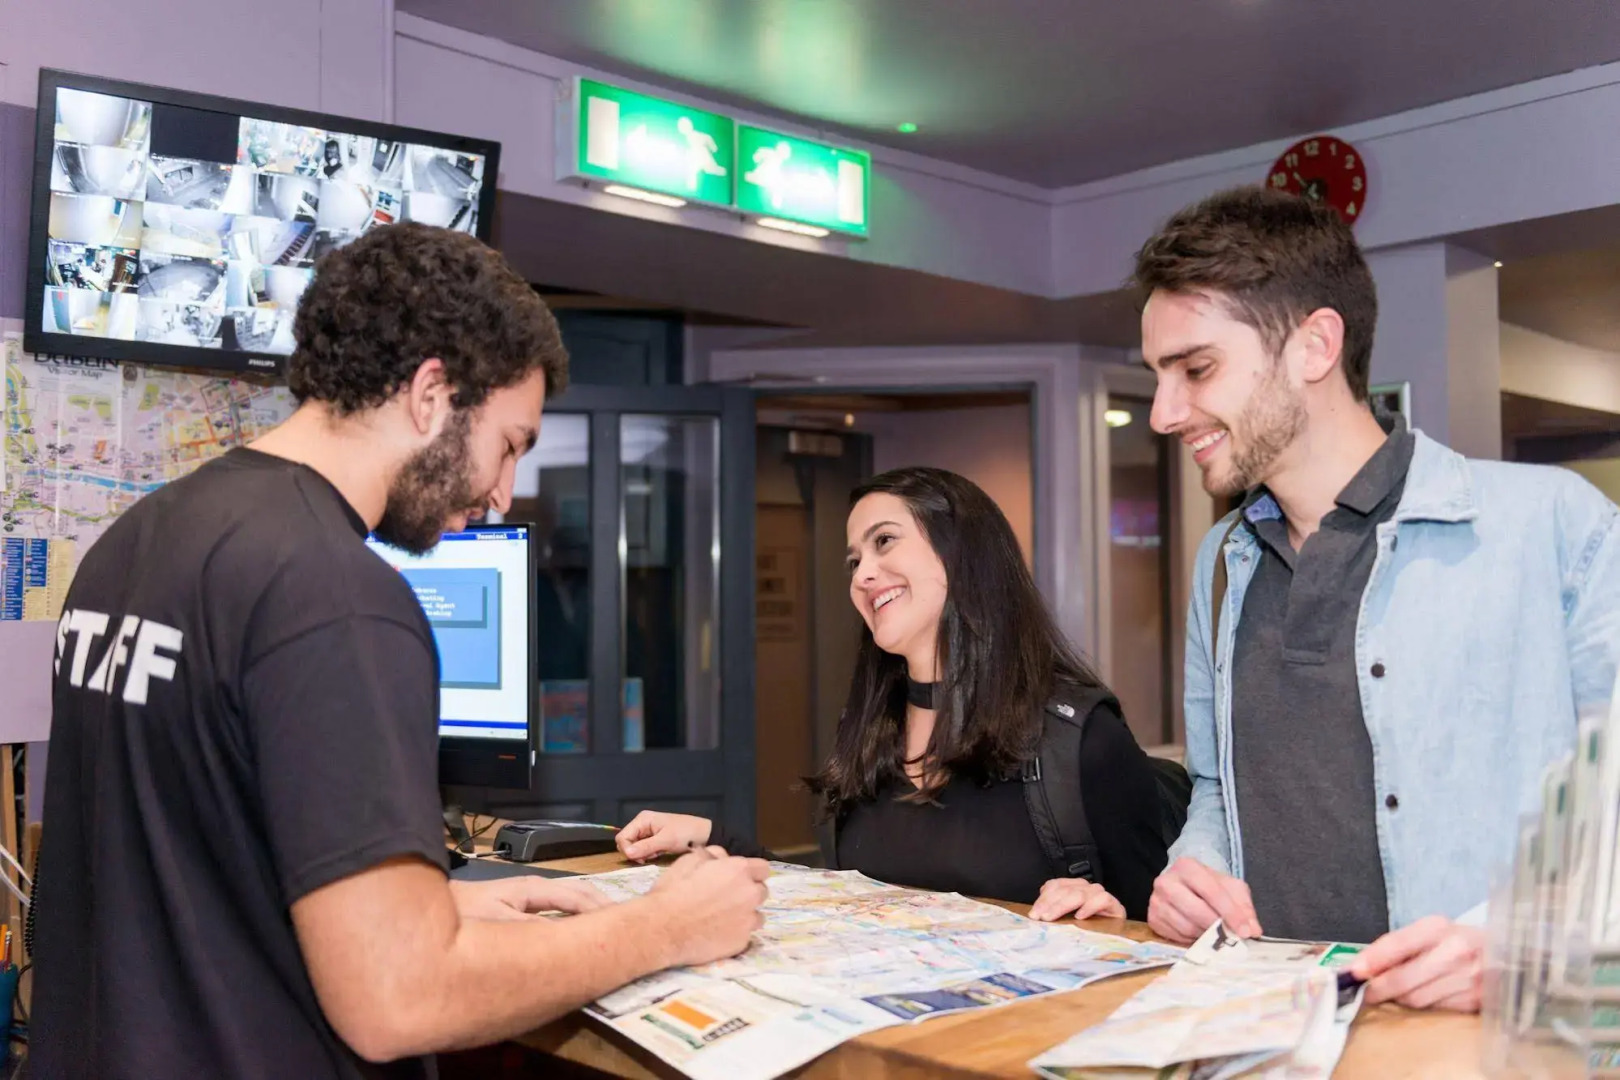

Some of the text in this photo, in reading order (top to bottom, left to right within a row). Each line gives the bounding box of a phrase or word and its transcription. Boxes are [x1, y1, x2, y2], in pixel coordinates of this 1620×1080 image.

[1304, 140, 1319, 156] 12
[1329, 142, 1337, 156] 1
[1285, 152, 1298, 168] 11
[1345, 154, 1355, 169] 2
[1272, 172, 1287, 188] 10
[1352, 176, 1362, 191] 3
[1346, 201, 1356, 215] 4
[248, 358, 276, 368] PHILIPS
[81, 369, 103, 380] Map
[476, 532, 508, 540] Terminal
